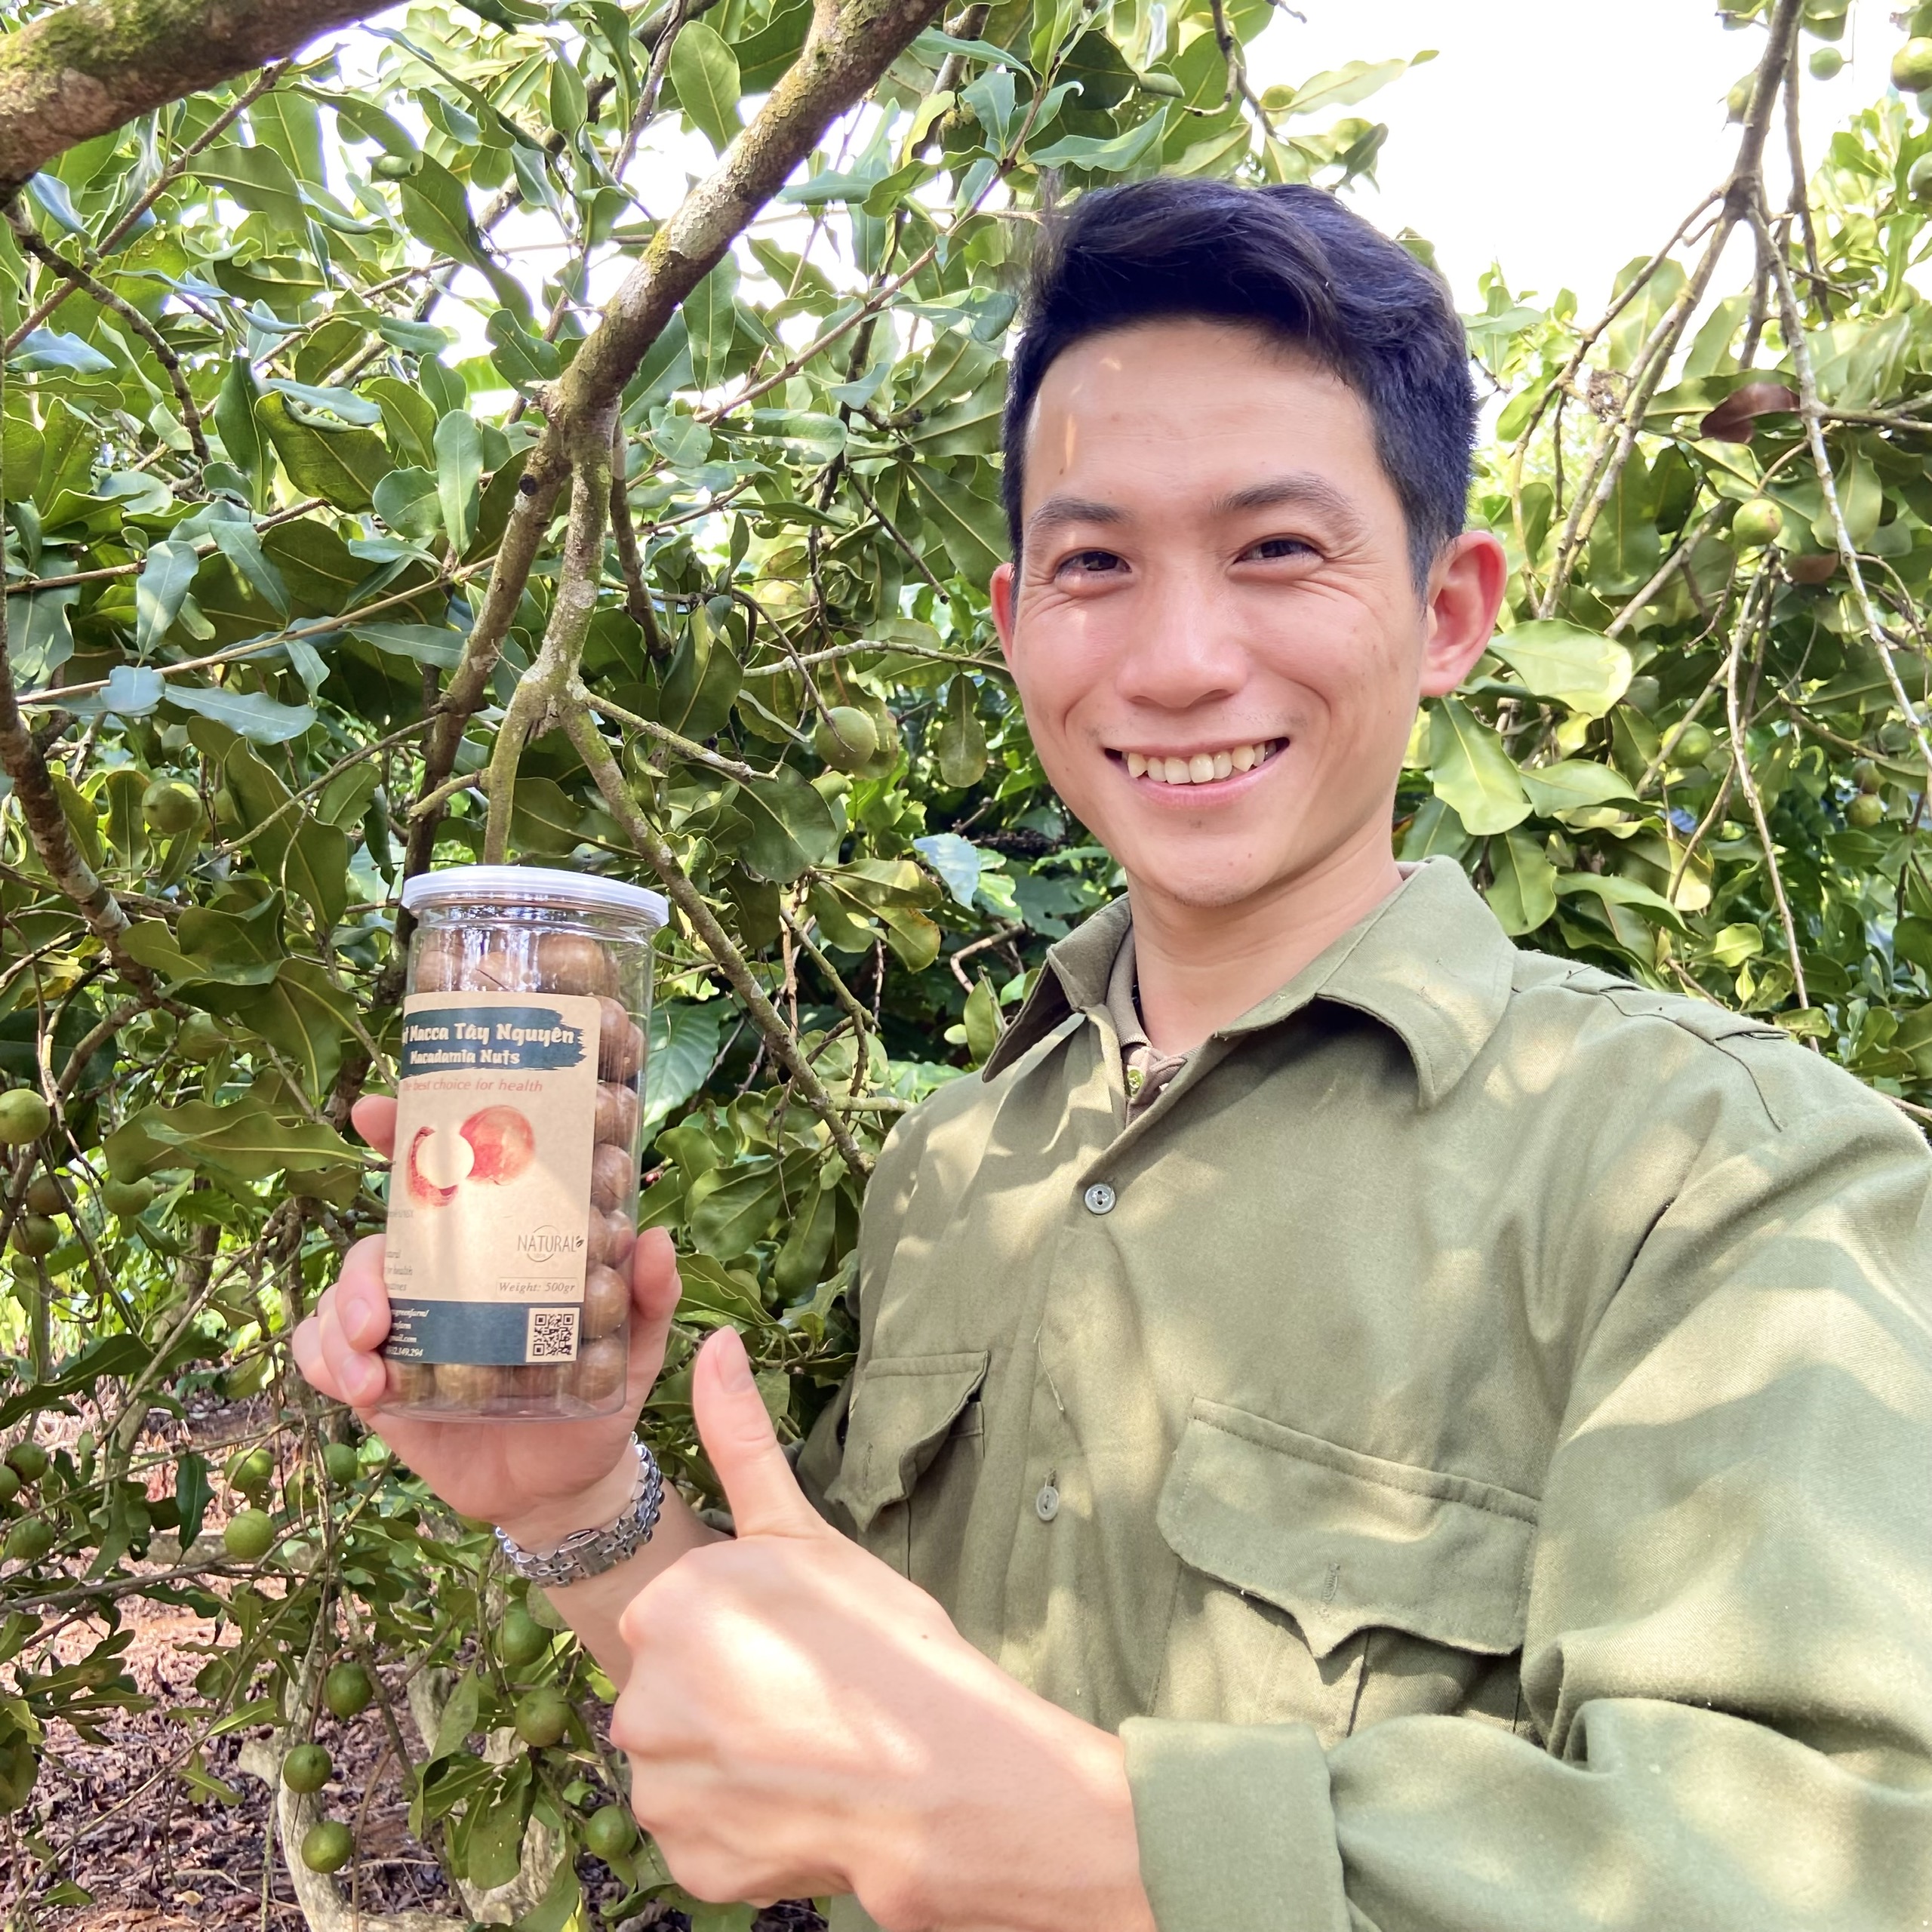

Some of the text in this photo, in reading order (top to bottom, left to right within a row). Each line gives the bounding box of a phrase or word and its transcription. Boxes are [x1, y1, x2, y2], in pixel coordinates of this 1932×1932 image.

[454, 1023, 489, 1044] Tây
[497, 1023, 574, 1047] Nguyên
[411, 1049, 520, 1065] Macadamia Nuts
[433, 1078, 471, 1091] choice
[475, 1078, 494, 1091] for
[498, 1079, 543, 1092] health
[517, 1235, 577, 1252] NATURAL
[500, 1282, 575, 1294] Weight: 500gr
